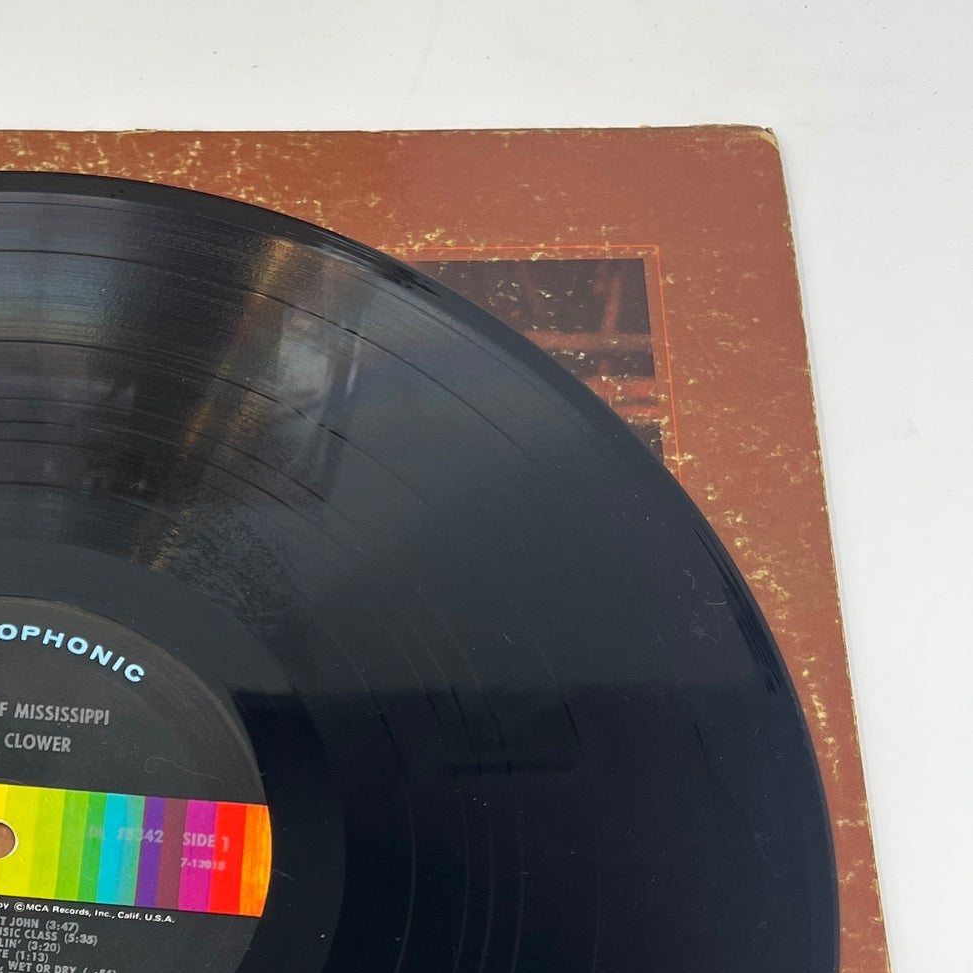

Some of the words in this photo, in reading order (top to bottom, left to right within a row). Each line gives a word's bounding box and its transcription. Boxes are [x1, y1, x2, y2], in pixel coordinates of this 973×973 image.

[14, 703, 109, 725] MISSISSIPPI
[4, 733, 71, 752] CLOWER
[183, 832, 215, 848] SIDE
[222, 836, 229, 852] 1
[52, 906, 91, 917] Records,
[95, 910, 115, 919] Inc.,
[118, 911, 141, 920] Calif.
[145, 914, 175, 923] U.S.A.
[9, 917, 39, 928] JOHN
[45, 920, 79, 933] (3:47)
[25, 930, 57, 941] CLASS
[64, 932, 98, 946] (5:35)
[28, 941, 60, 954] (3:20)
[16, 951, 49, 963] (1:13)
[8, 962, 32, 972] WET
[36, 963, 50, 973] OR
